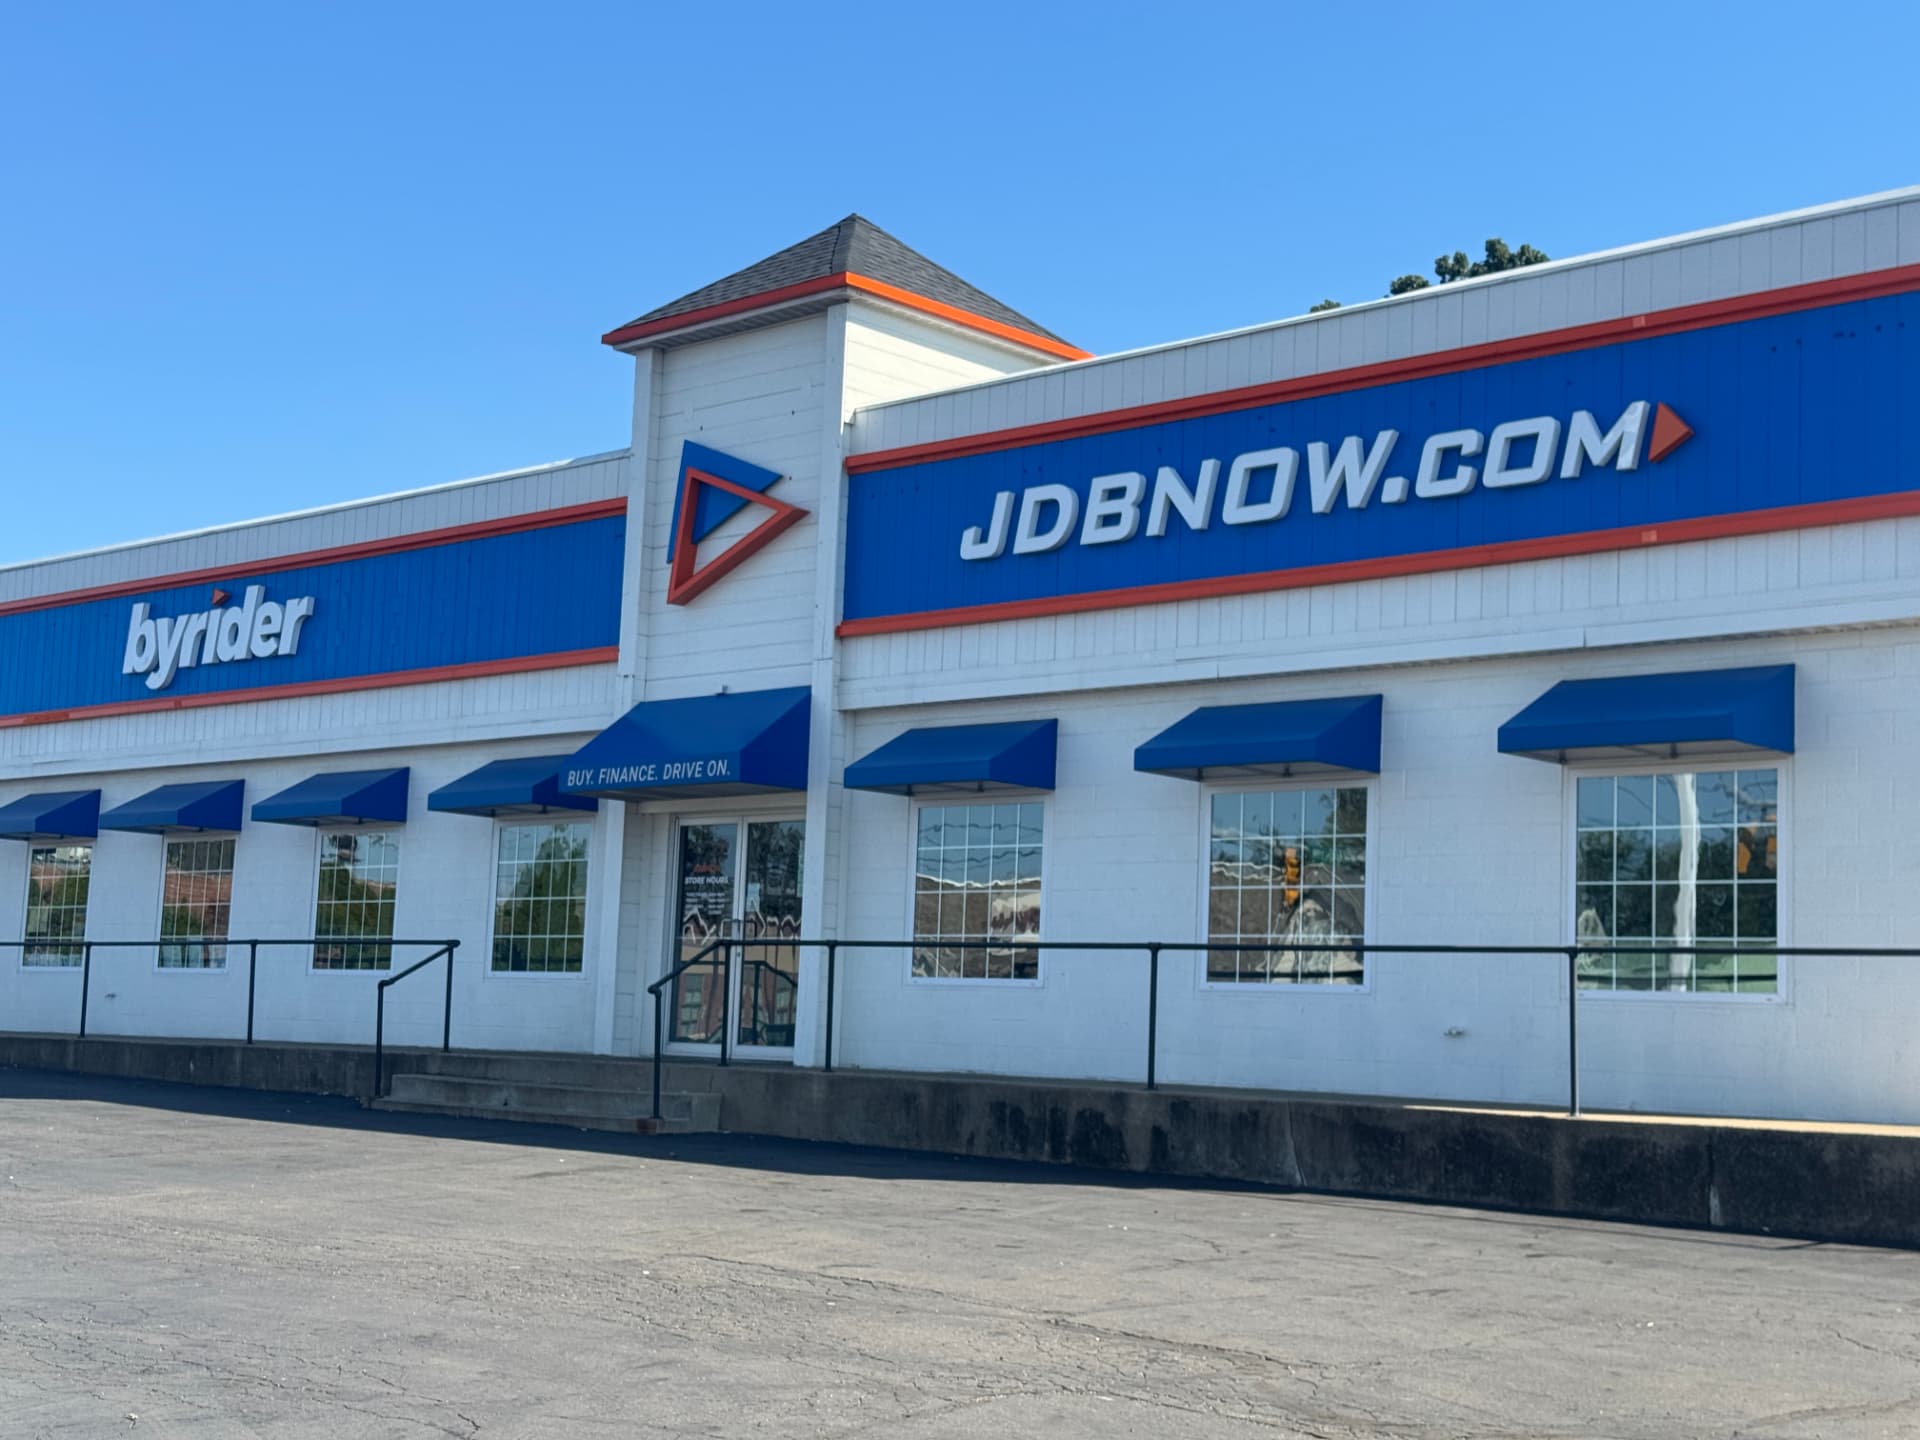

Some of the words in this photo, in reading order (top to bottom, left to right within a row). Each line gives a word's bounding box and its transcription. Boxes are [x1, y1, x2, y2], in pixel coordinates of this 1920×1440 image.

[960, 400, 1650, 560] JDBNOW.COM
[122, 585, 315, 690] byrider
[567, 769, 594, 787] BUY.
[598, 765, 658, 785] FINANCE.
[663, 761, 703, 780] DRIVE
[707, 759, 731, 777] ON.
[685, 876, 705, 885] STORE
